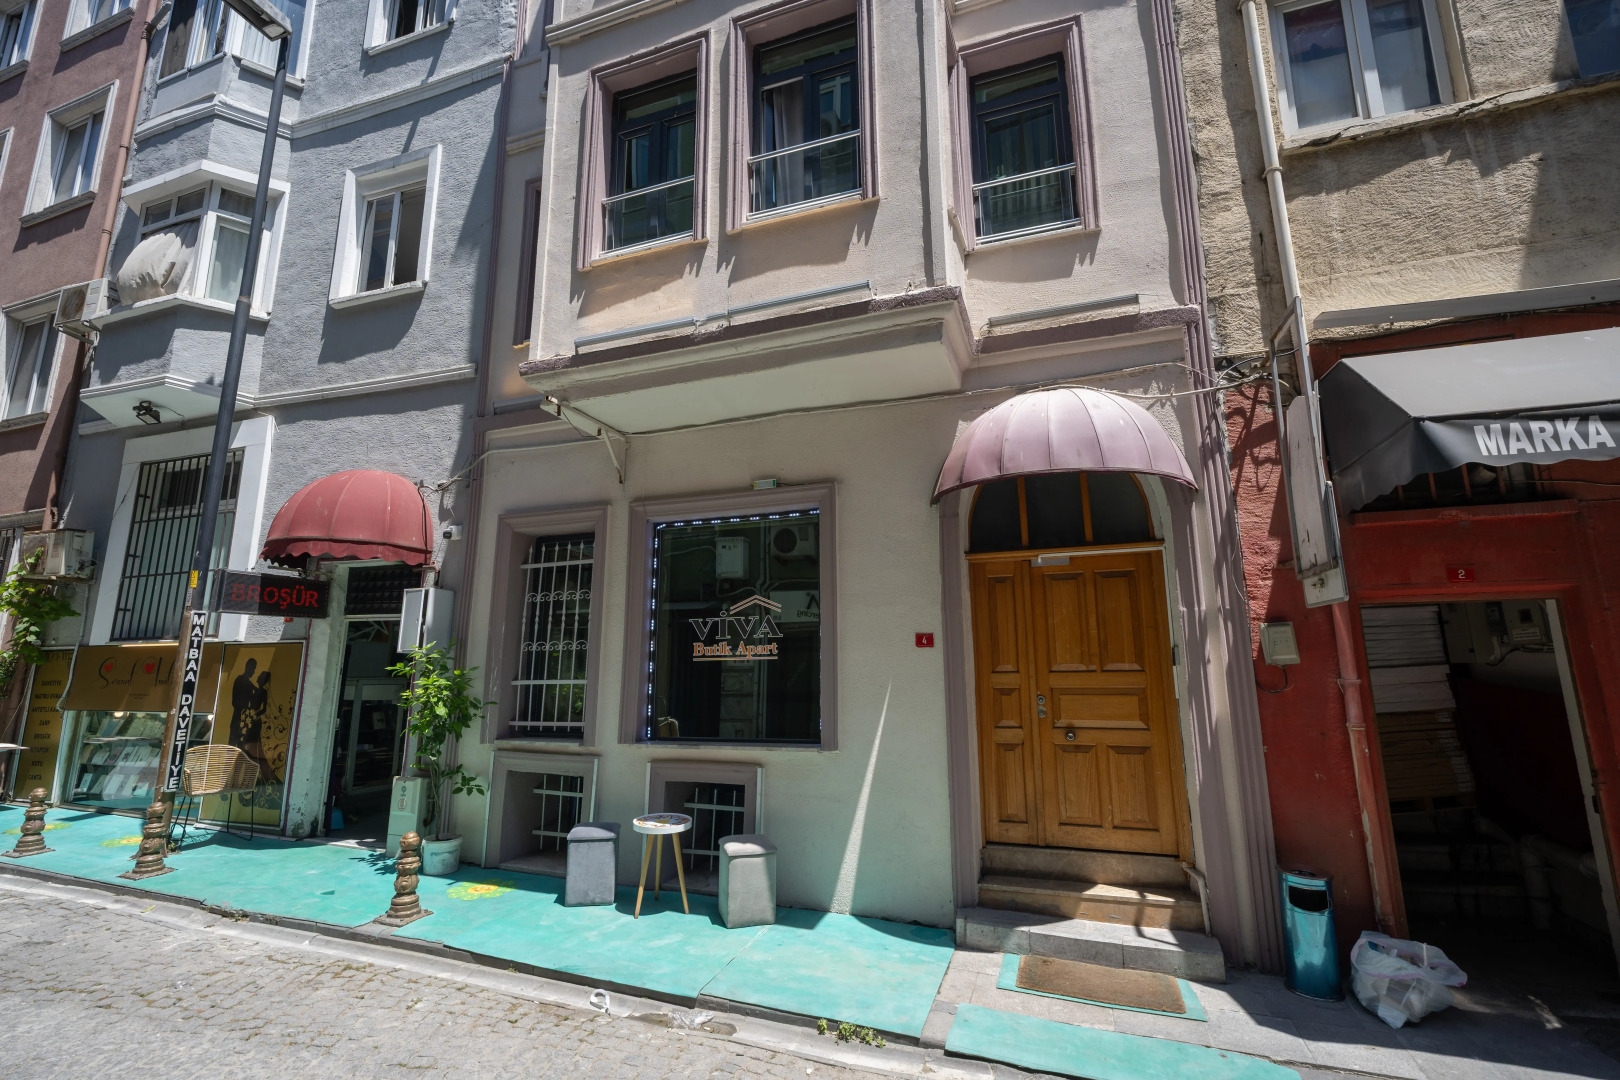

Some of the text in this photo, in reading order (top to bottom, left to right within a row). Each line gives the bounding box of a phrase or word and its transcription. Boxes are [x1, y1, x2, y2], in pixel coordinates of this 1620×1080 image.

[1473, 415, 1616, 456] MARKA
[1458, 569, 1466, 579] 2
[231, 583, 319, 610] BROŞÜR
[693, 641, 778, 658] Butik Apart
[168, 614, 205, 790] MATBAA DAVETİYE
